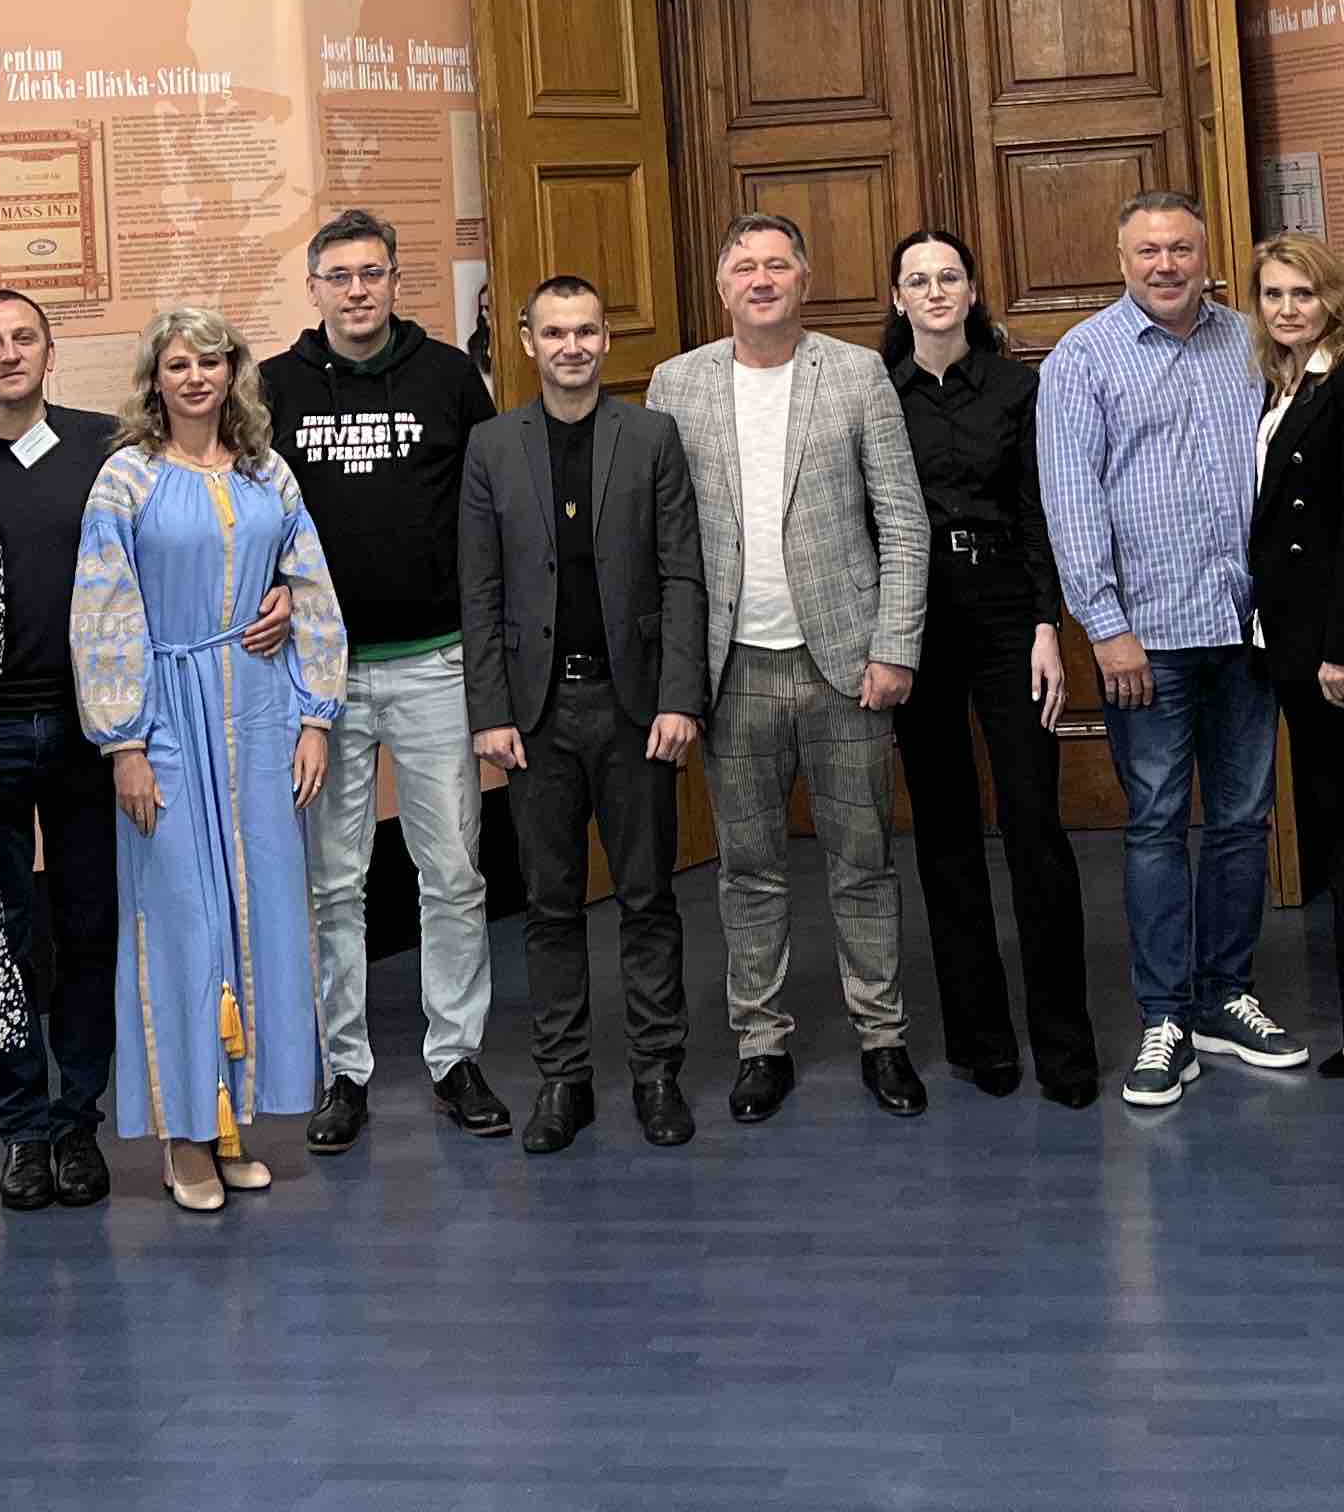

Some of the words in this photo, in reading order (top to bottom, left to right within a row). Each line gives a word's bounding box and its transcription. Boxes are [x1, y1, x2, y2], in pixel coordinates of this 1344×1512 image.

[1301, 0, 1319, 30] und
[406, 65, 439, 92] Marie
[1, 204, 43, 220] MASS
[47, 204, 62, 218] IN
[67, 204, 78, 216] D
[295, 424, 424, 449] UNIVERSITY
[307, 447, 323, 462] IN
